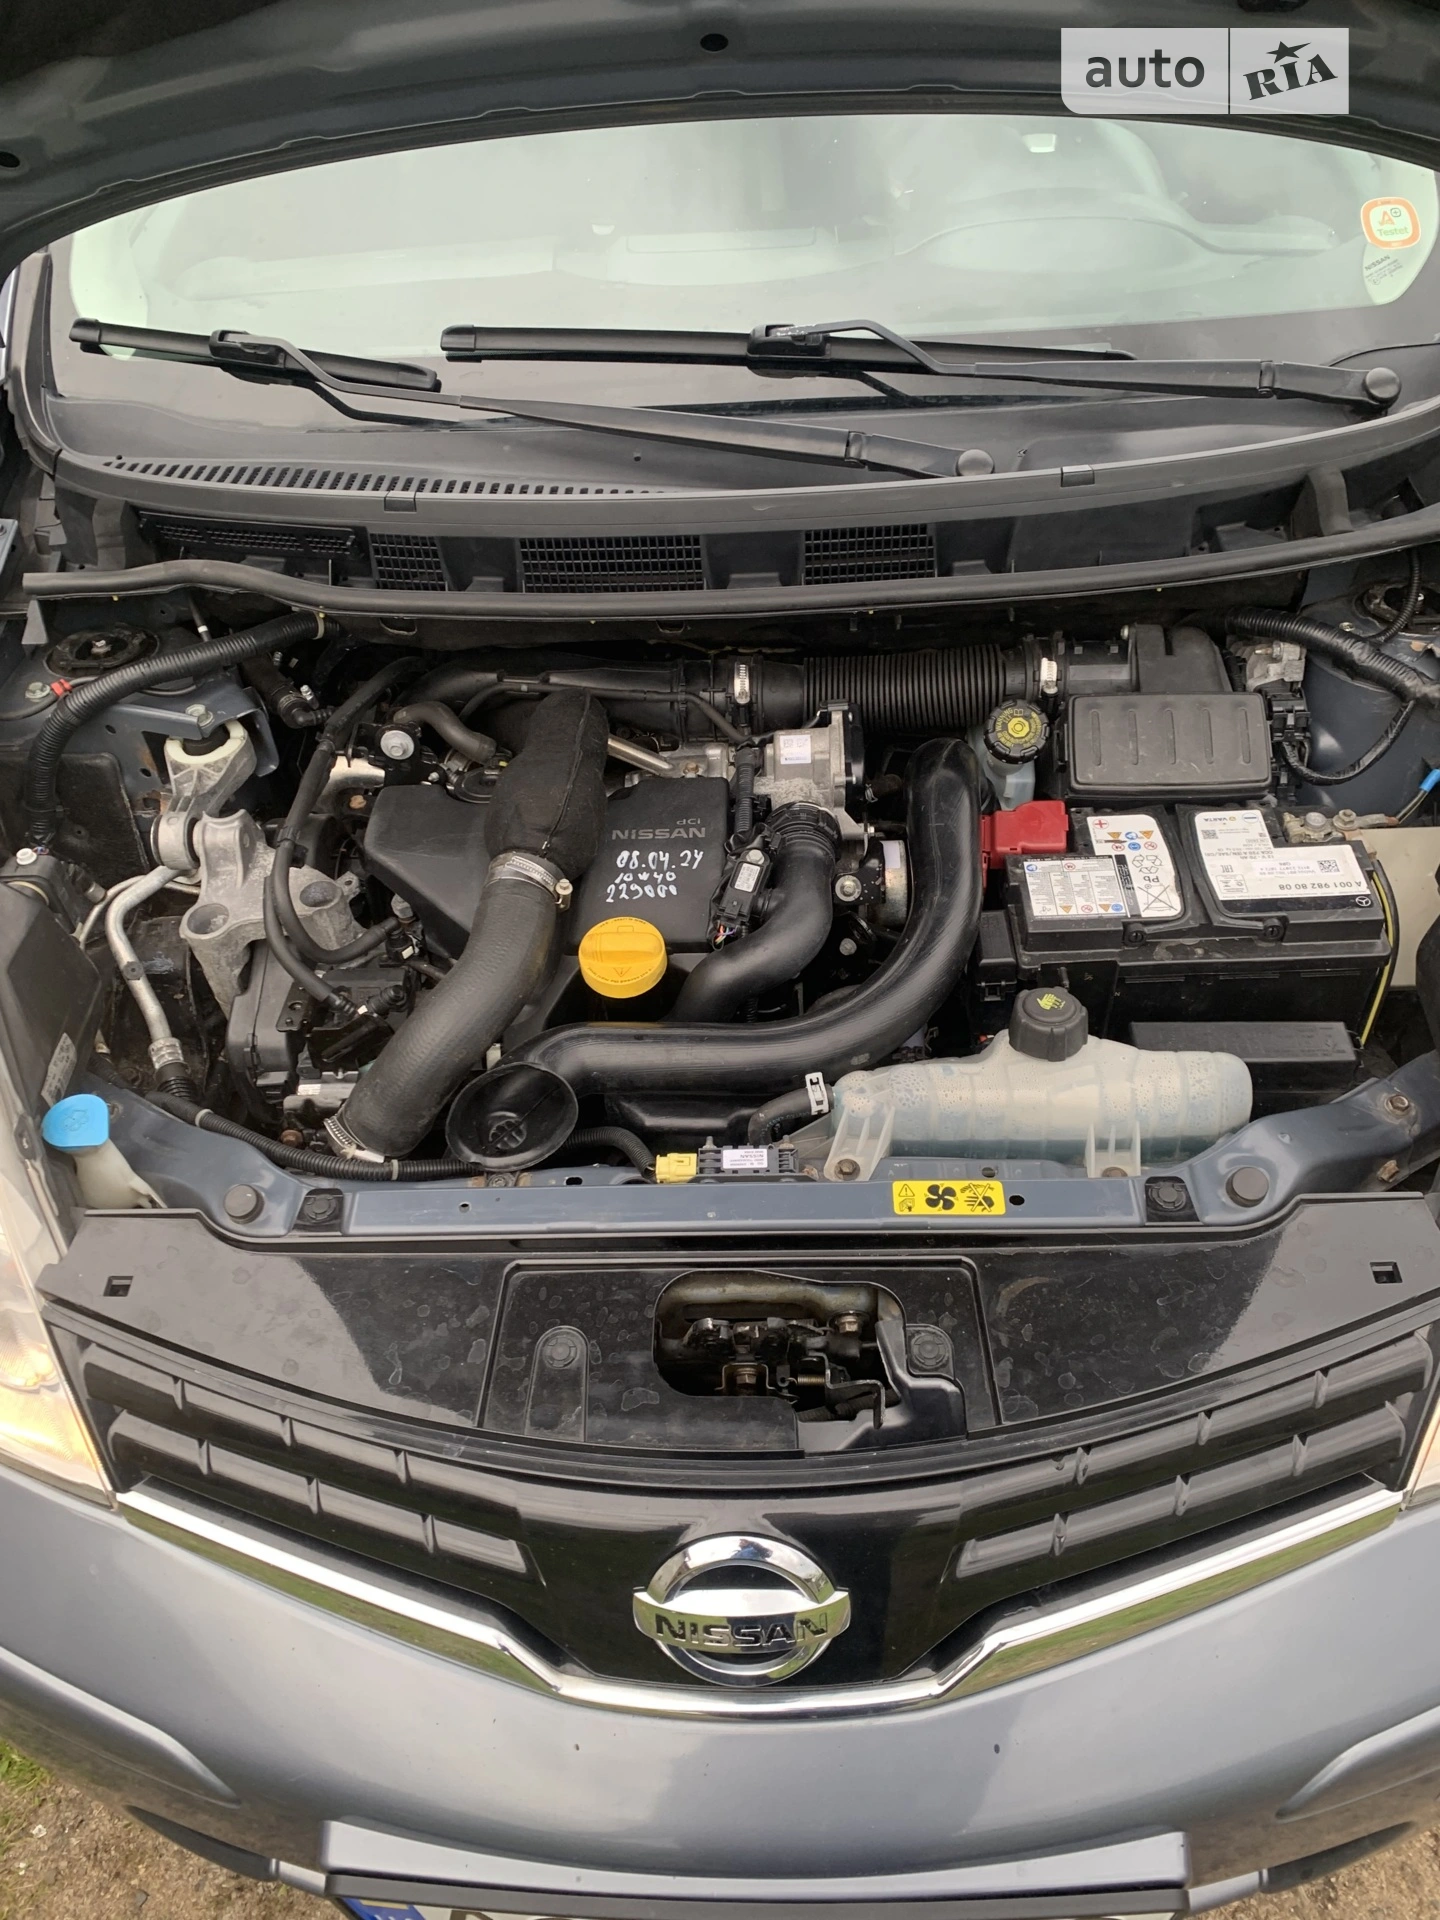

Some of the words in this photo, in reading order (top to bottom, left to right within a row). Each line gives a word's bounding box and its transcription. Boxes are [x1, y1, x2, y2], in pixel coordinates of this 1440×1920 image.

[1377, 226, 1409, 236] Testet
[1364, 254, 1391, 271] NISSAN
[611, 827, 706, 840] NISSAN
[616, 849, 704, 870] 08.04.24
[1143, 875, 1160, 883] Pb
[1310, 882, 1329, 890] 982
[1333, 881, 1352, 889] 001
[654, 1612, 828, 1647] NISSAN
